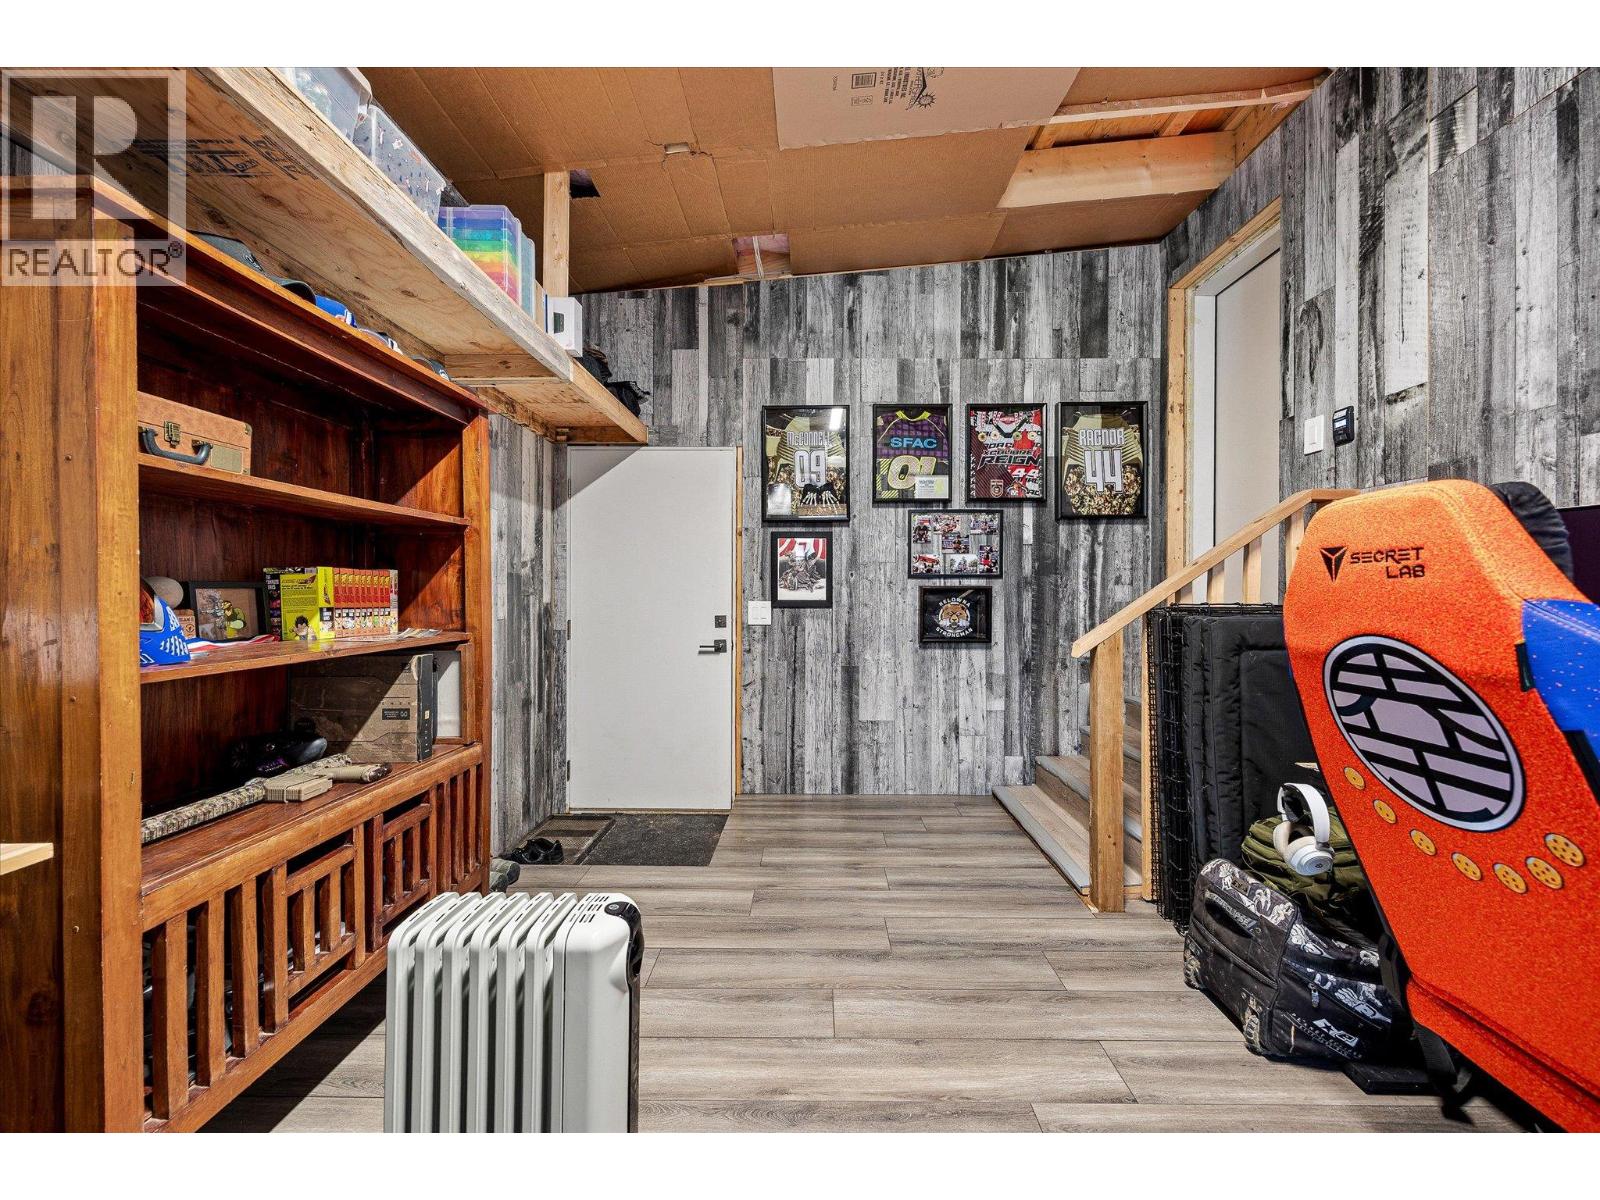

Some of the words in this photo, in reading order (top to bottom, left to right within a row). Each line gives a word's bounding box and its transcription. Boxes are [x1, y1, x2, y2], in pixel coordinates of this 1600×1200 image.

[890, 437, 937, 449] SFAC
[1079, 428, 1125, 446] RAGNOR
[794, 450, 827, 488] 09
[978, 455, 1040, 469] REIGN
[1084, 449, 1123, 492] 44
[1350, 547, 1424, 564] SECRET
[1386, 564, 1425, 579] LAB
[935, 626, 973, 638] STRONGMAN
